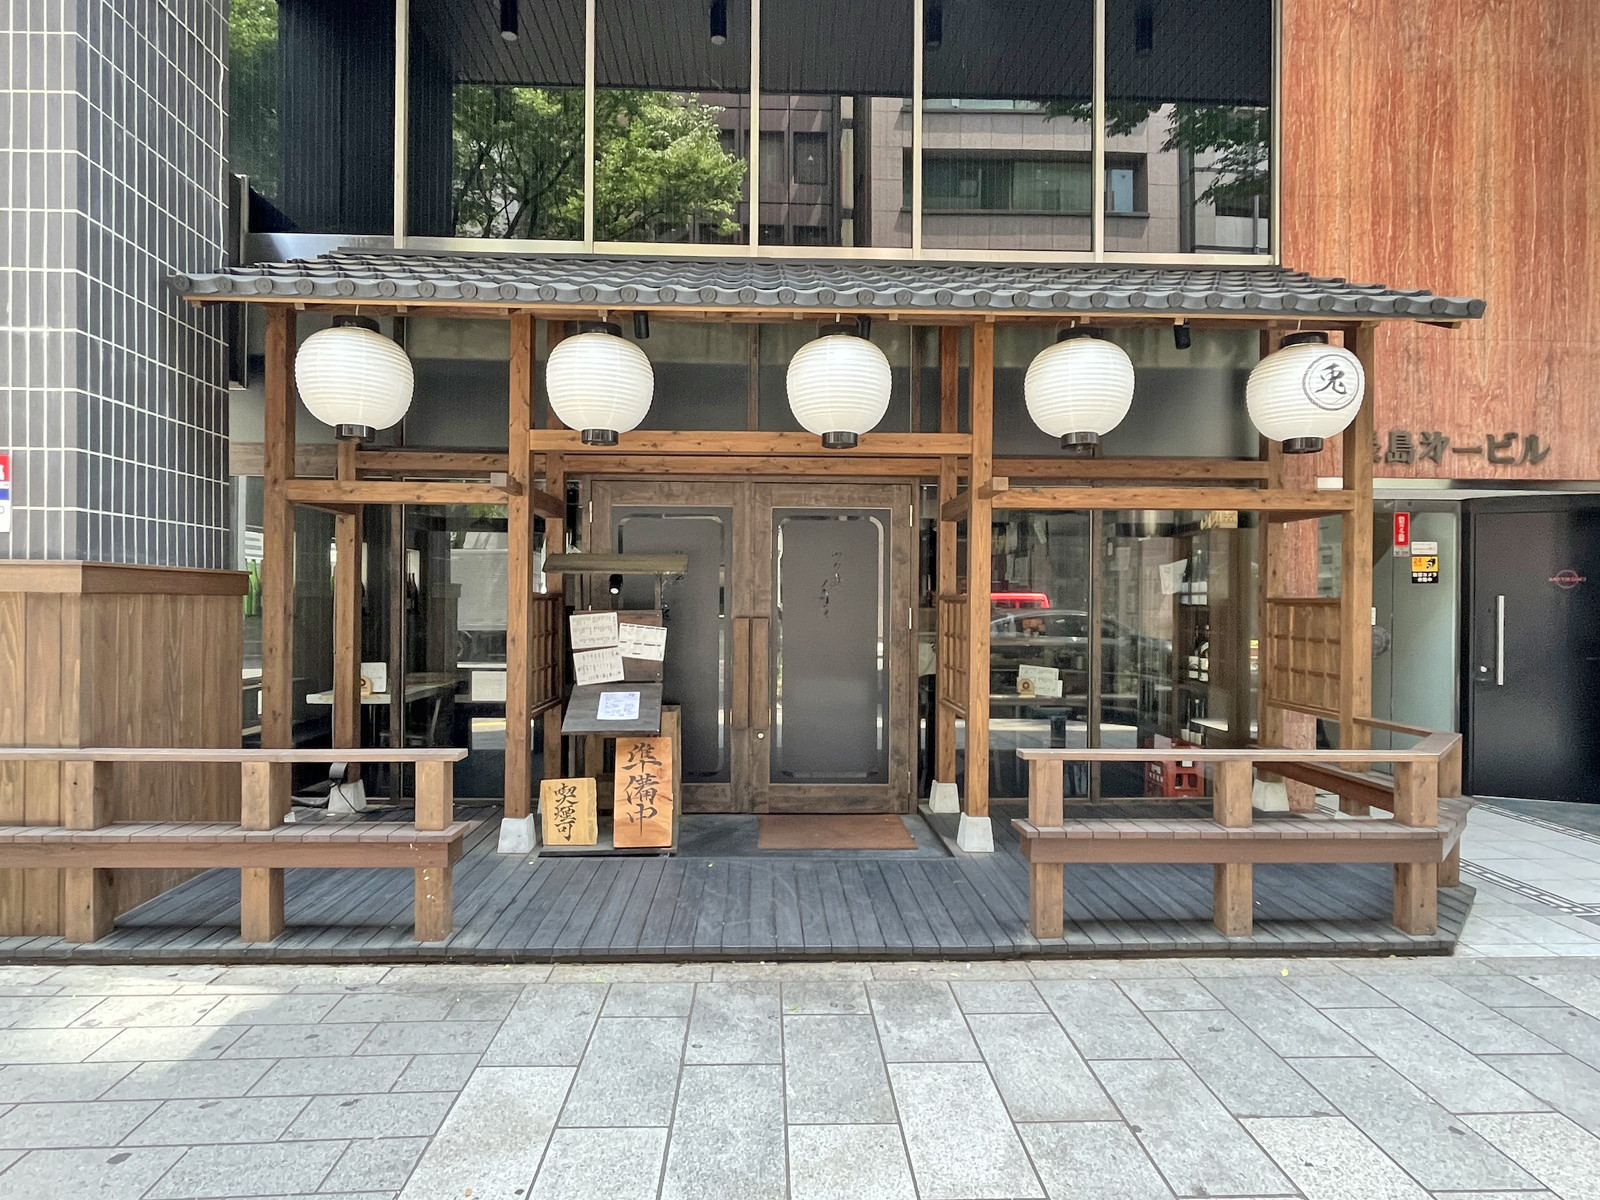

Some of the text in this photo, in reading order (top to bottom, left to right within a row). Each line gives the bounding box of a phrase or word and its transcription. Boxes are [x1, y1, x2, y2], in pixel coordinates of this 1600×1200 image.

[553, 782, 580, 842] 喫煙可
[622, 742, 663, 838] 準備中
